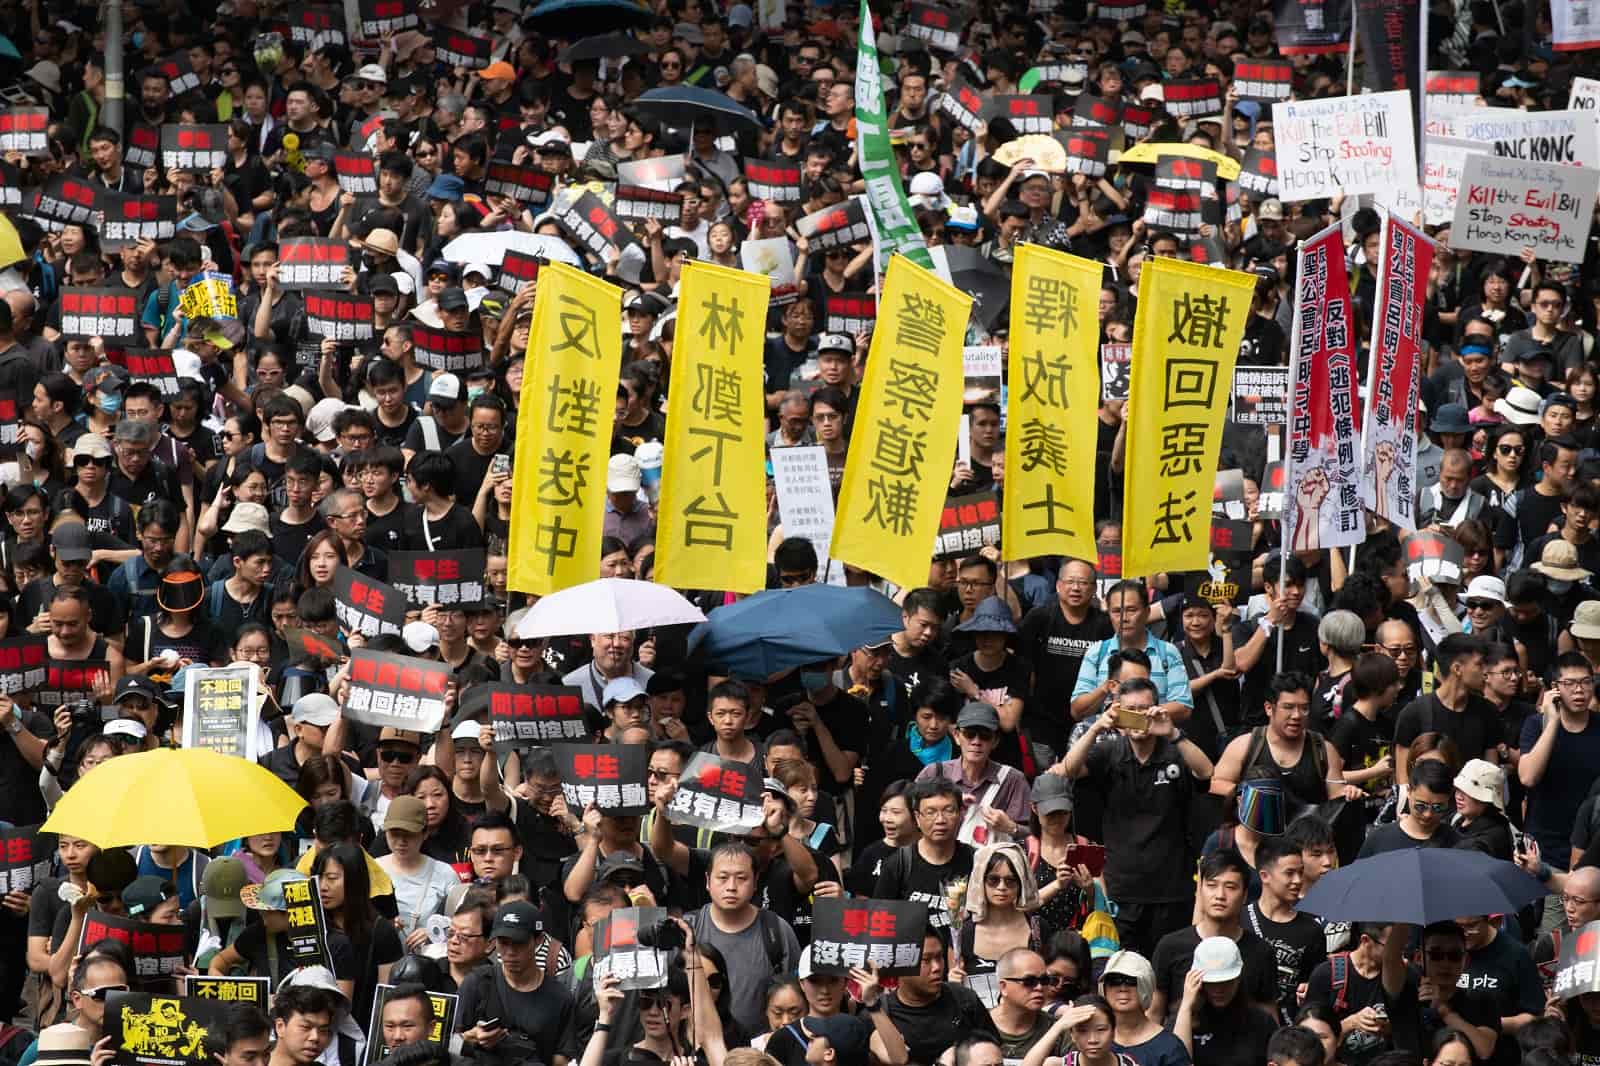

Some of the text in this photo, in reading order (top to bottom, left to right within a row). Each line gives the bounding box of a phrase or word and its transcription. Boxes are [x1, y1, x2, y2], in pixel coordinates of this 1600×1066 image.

[1364, 111, 1388, 138] Bill
[1299, 140, 1335, 166] Stop
[1467, 184, 1496, 206] Kill
[1496, 188, 1519, 204] the
[1525, 189, 1557, 212] Evil
[1469, 207, 1503, 225] Stop
[1467, 223, 1502, 244] Hong
[1505, 227, 1538, 247] Kong
[965, 351, 998, 362] utality!
[1326, 300, 1358, 532] 反對《逃犯條例》修訂
[494, 719, 587, 742] 撤回控罪
[843, 909, 897, 938] 學生
[814, 940, 921, 970] 沒有暴動
[197, 981, 257, 1002] 不撤回
[1472, 974, 1498, 989] plz
